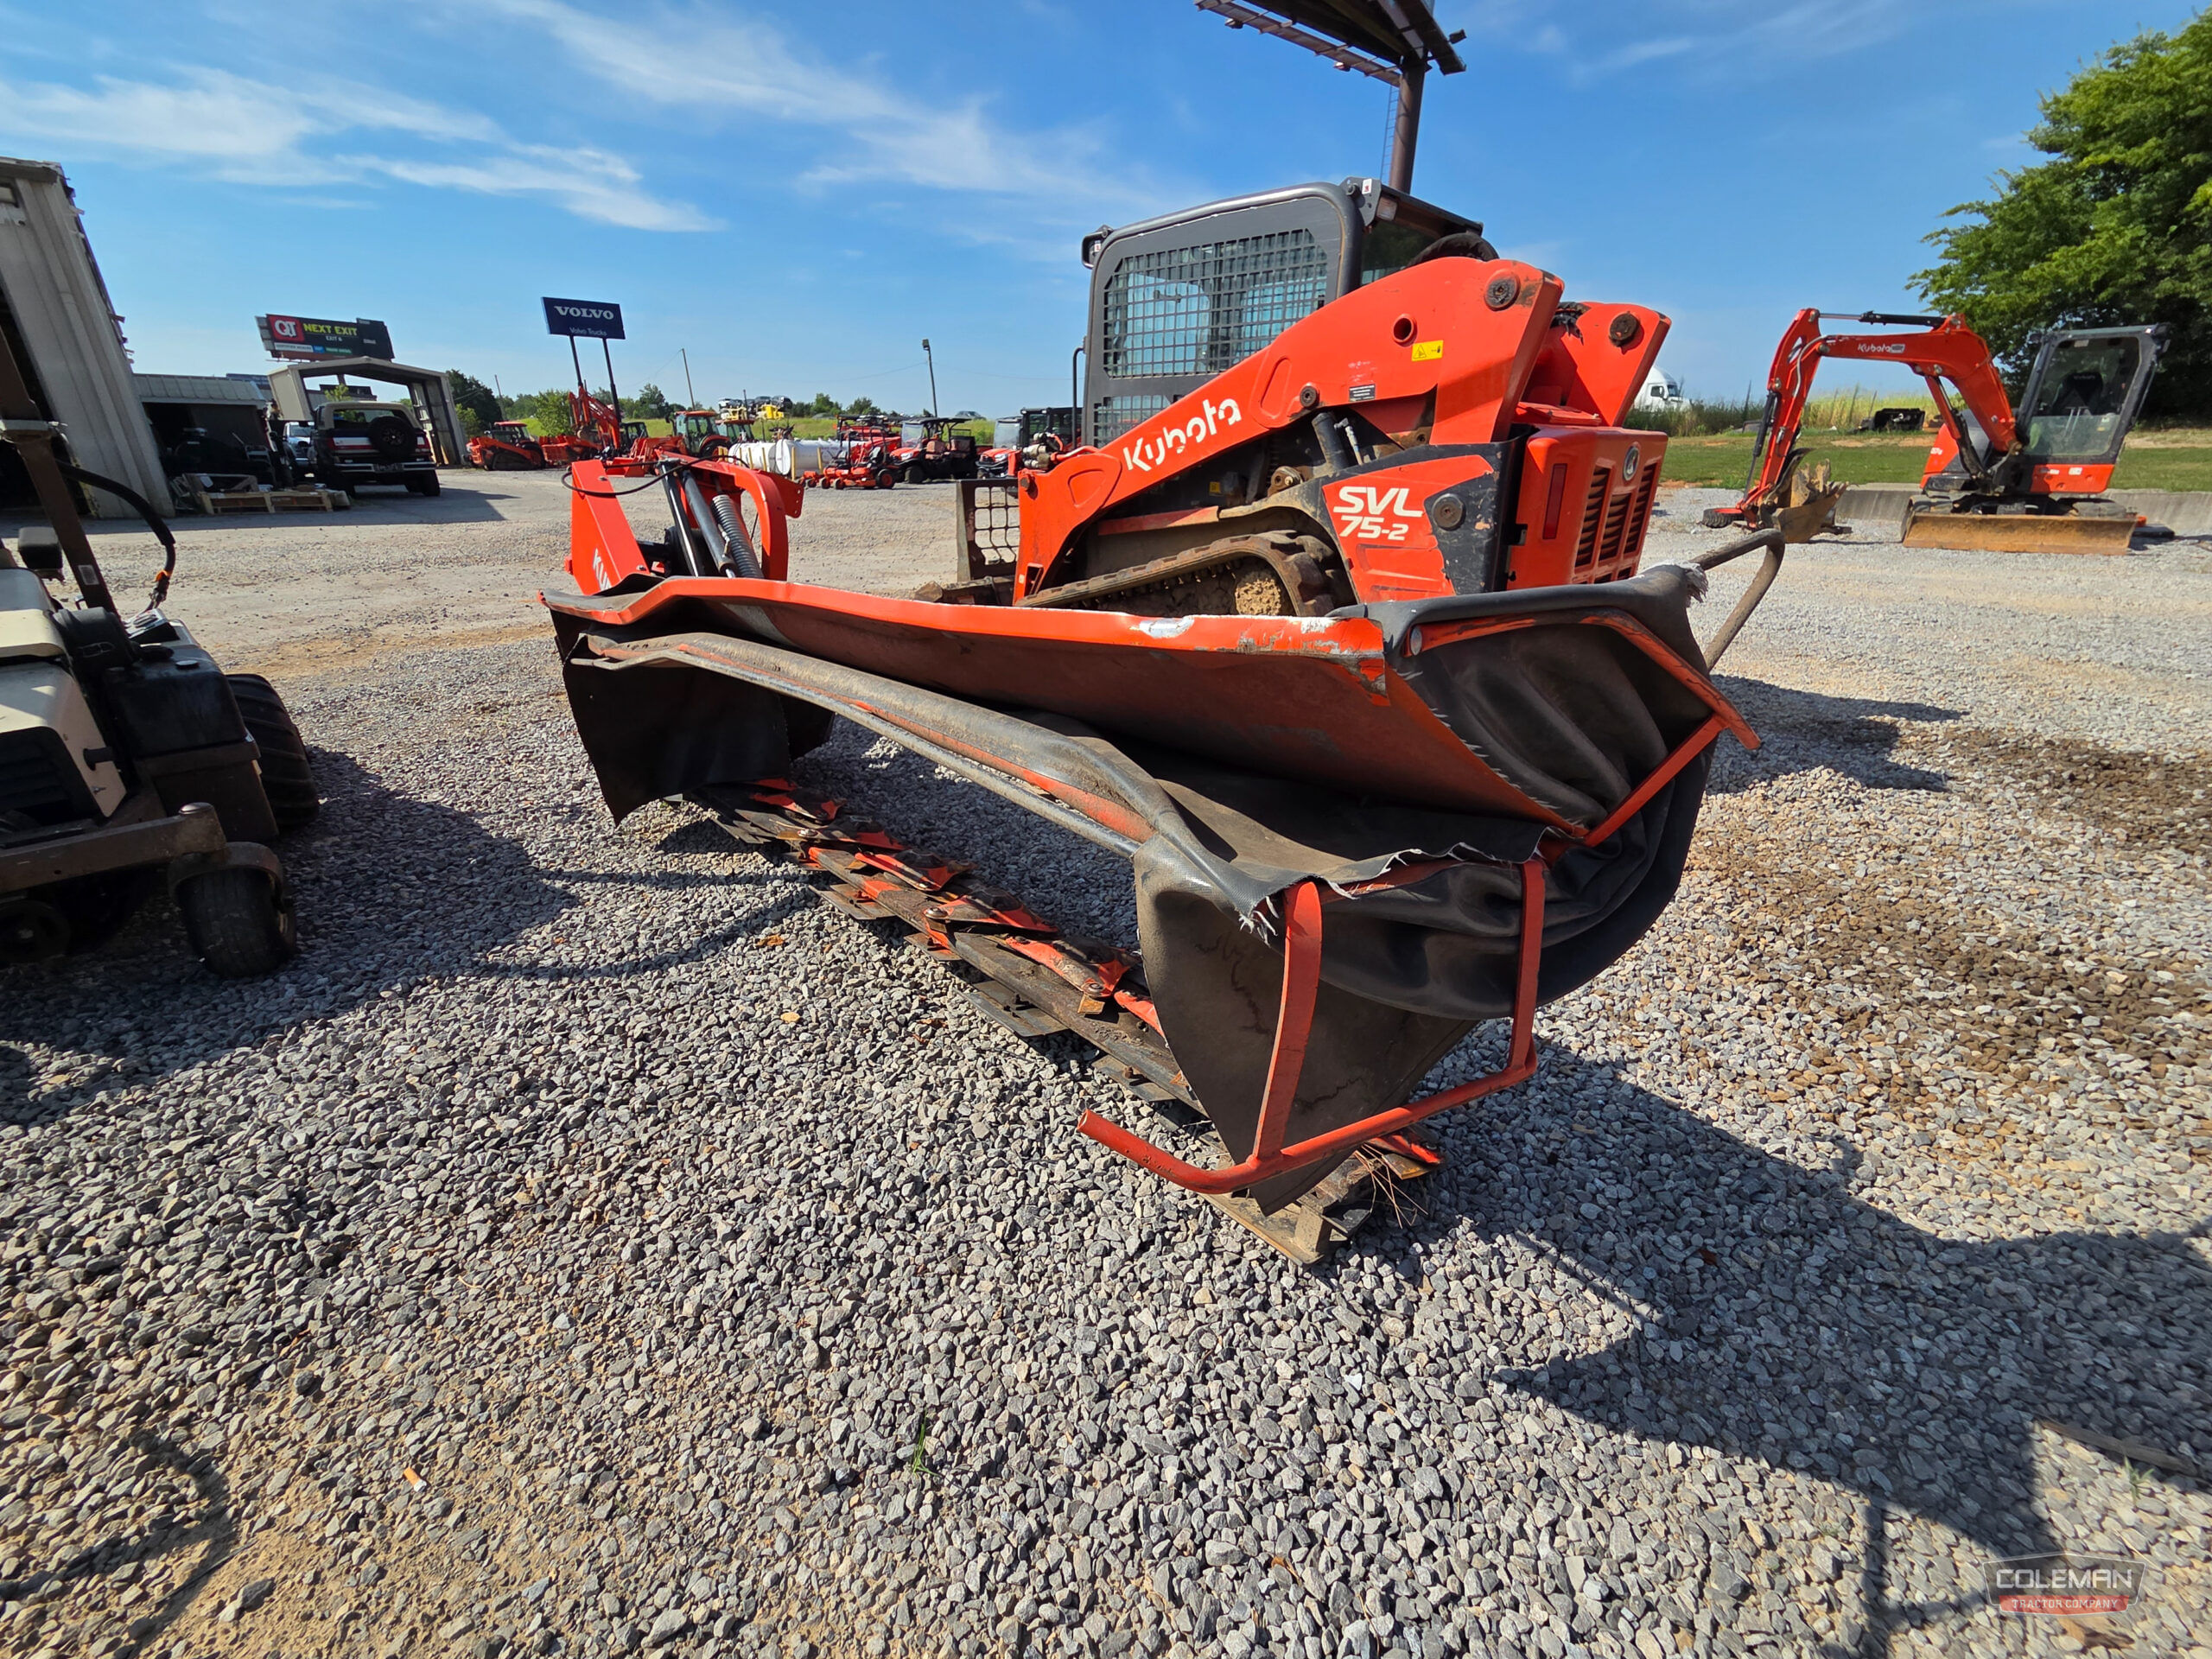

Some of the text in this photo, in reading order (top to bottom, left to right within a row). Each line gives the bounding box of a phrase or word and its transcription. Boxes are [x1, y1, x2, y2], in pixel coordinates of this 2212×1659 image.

[554, 305, 614, 320] VOLVO
[274, 320, 297, 337] QT
[303, 323, 357, 336] NEXT EXIT
[1123, 398, 1242, 472] Kubota
[1332, 486, 1424, 518] SVL
[1338, 515, 1409, 541] 75-2
